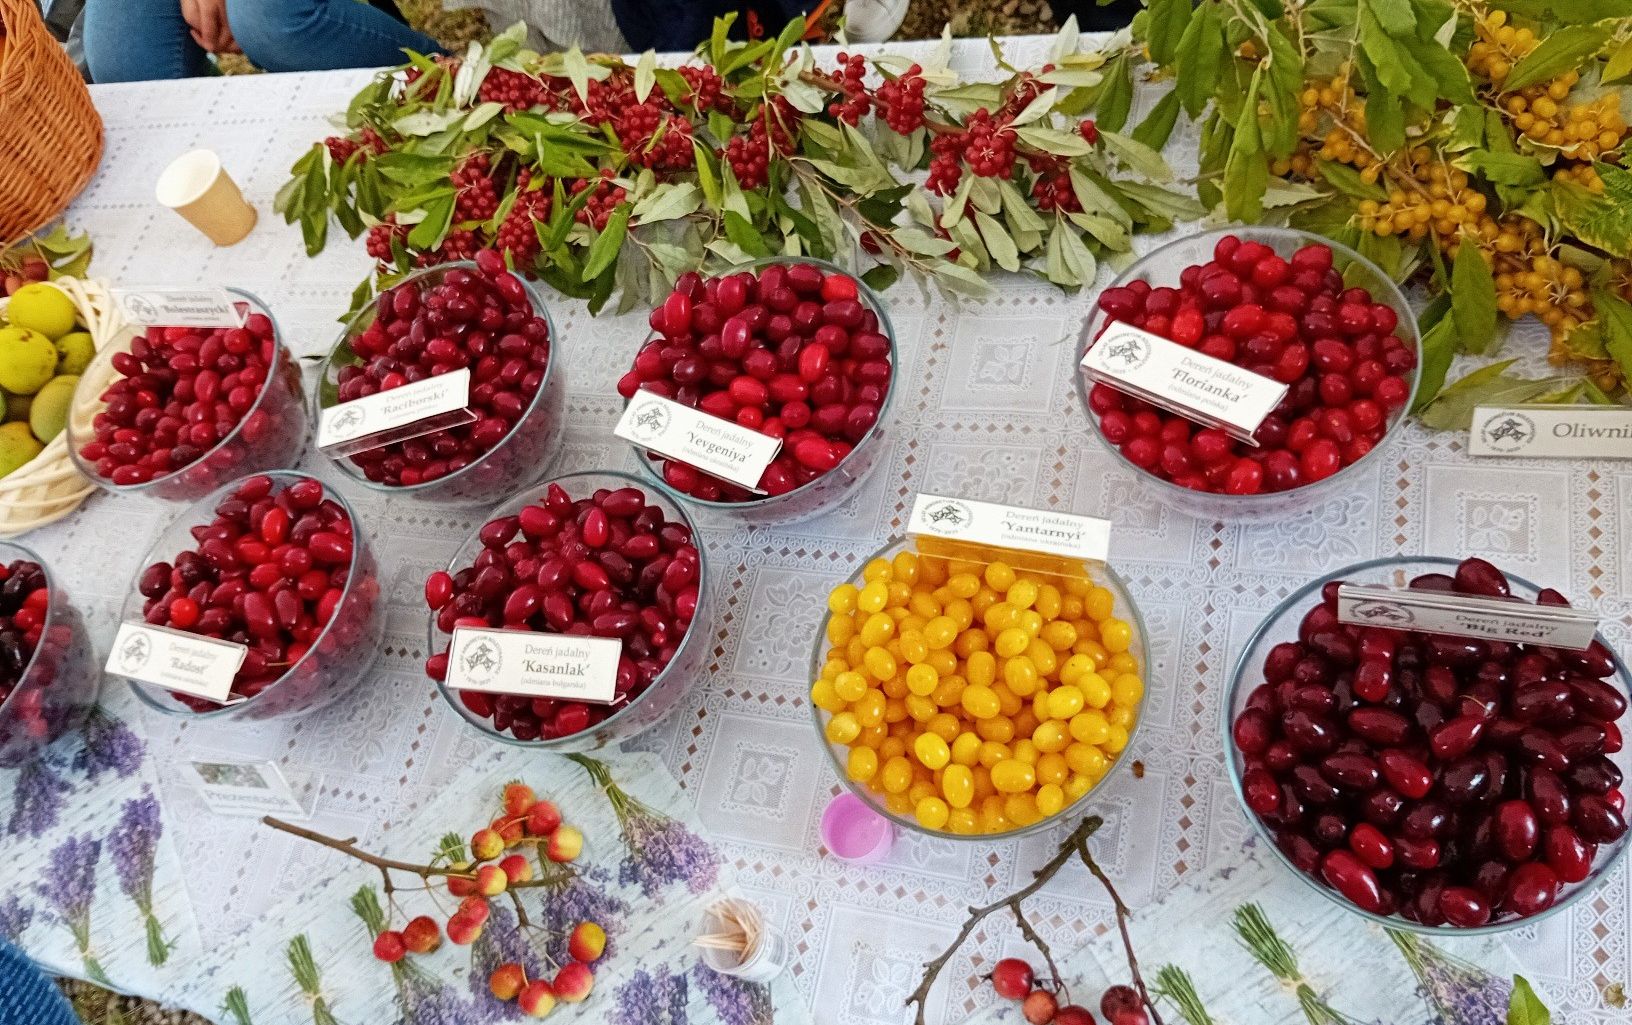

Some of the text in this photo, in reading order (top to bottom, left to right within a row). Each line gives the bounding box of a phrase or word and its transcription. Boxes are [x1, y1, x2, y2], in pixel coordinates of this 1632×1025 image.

[1181, 356, 1254, 390] Dereń jadalny
[696, 420, 754, 450] Dereń jadalny
[1552, 422, 1632, 438] Oliwni
[1006, 511, 1084, 529] Dereń jadalny
[1456, 615, 1558, 632] Dereń jadalny
[525, 643, 590, 661] Dereń jadalny
